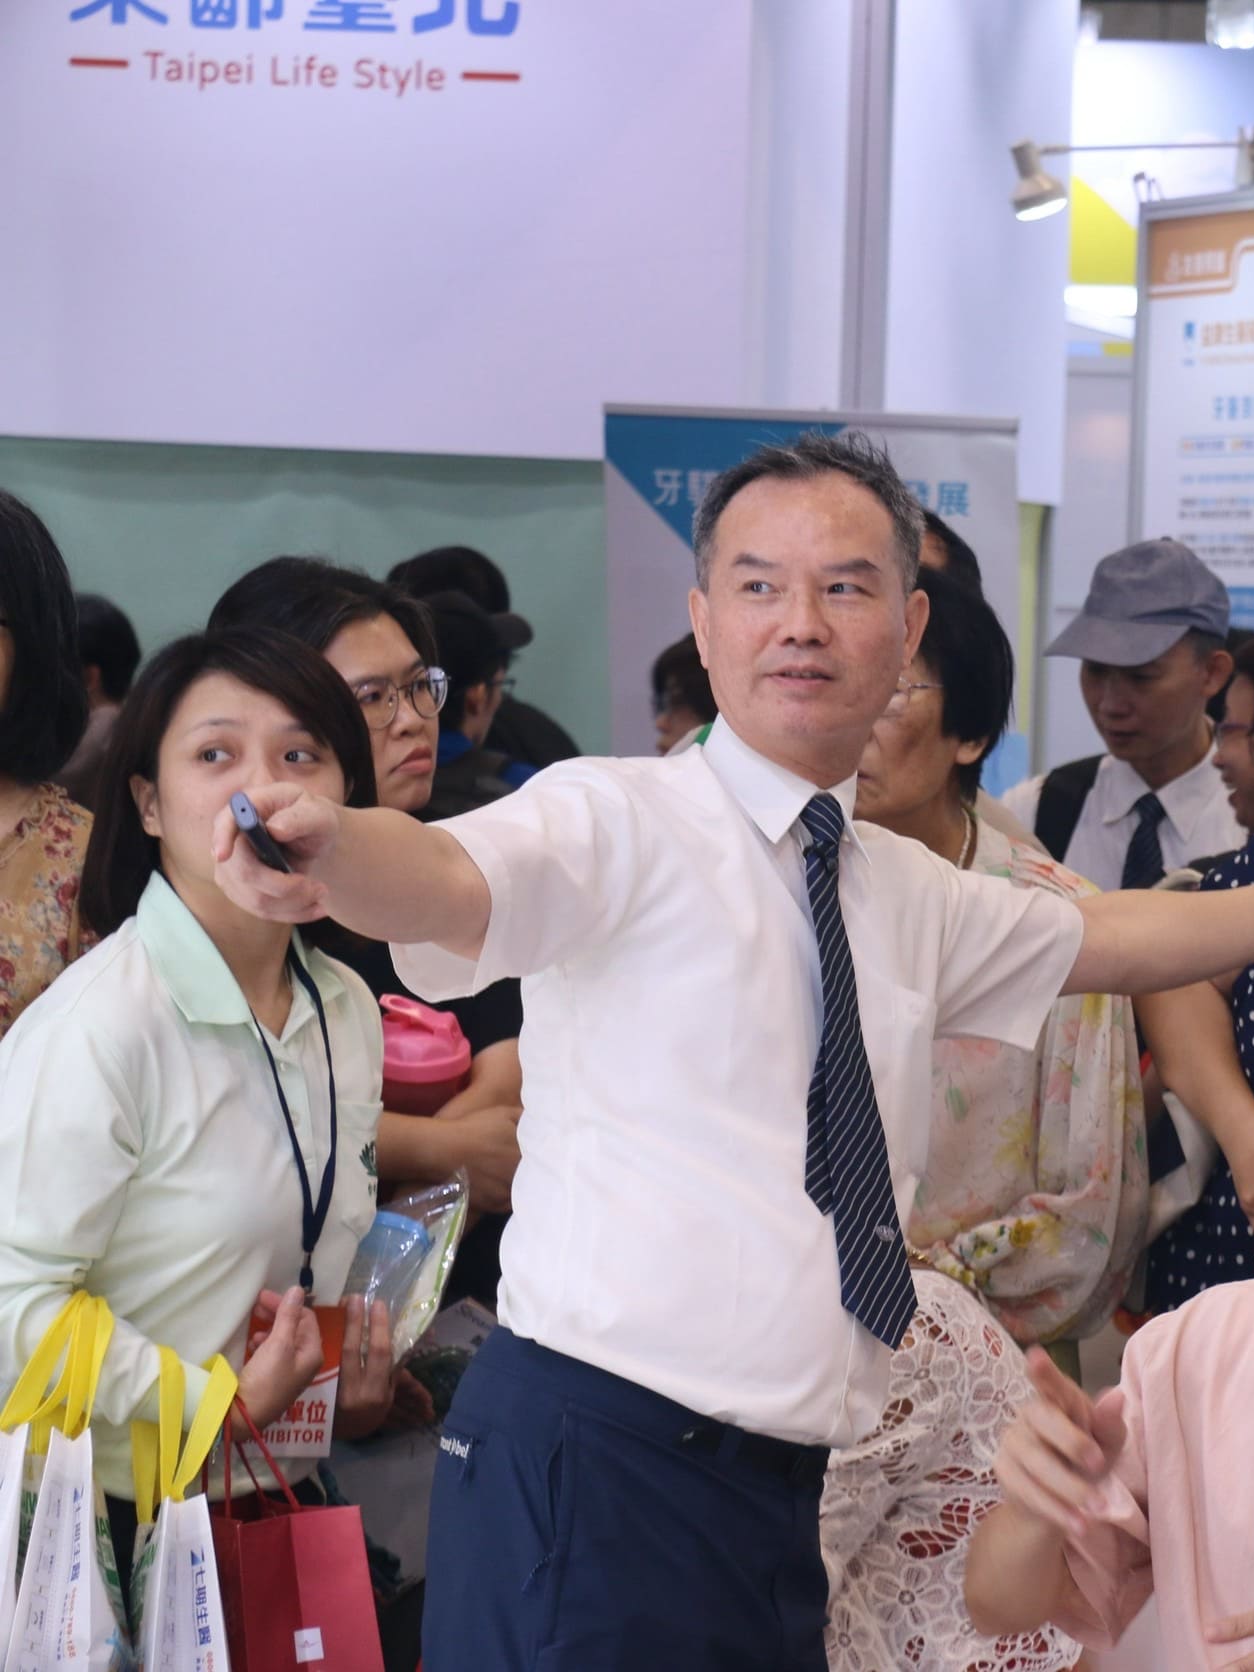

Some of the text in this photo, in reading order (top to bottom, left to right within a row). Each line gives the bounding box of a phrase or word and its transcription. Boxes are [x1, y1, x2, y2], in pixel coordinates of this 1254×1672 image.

[144, 50, 445, 98] Taipei Life Style
[241, 1428, 325, 1444] HIBITOR
